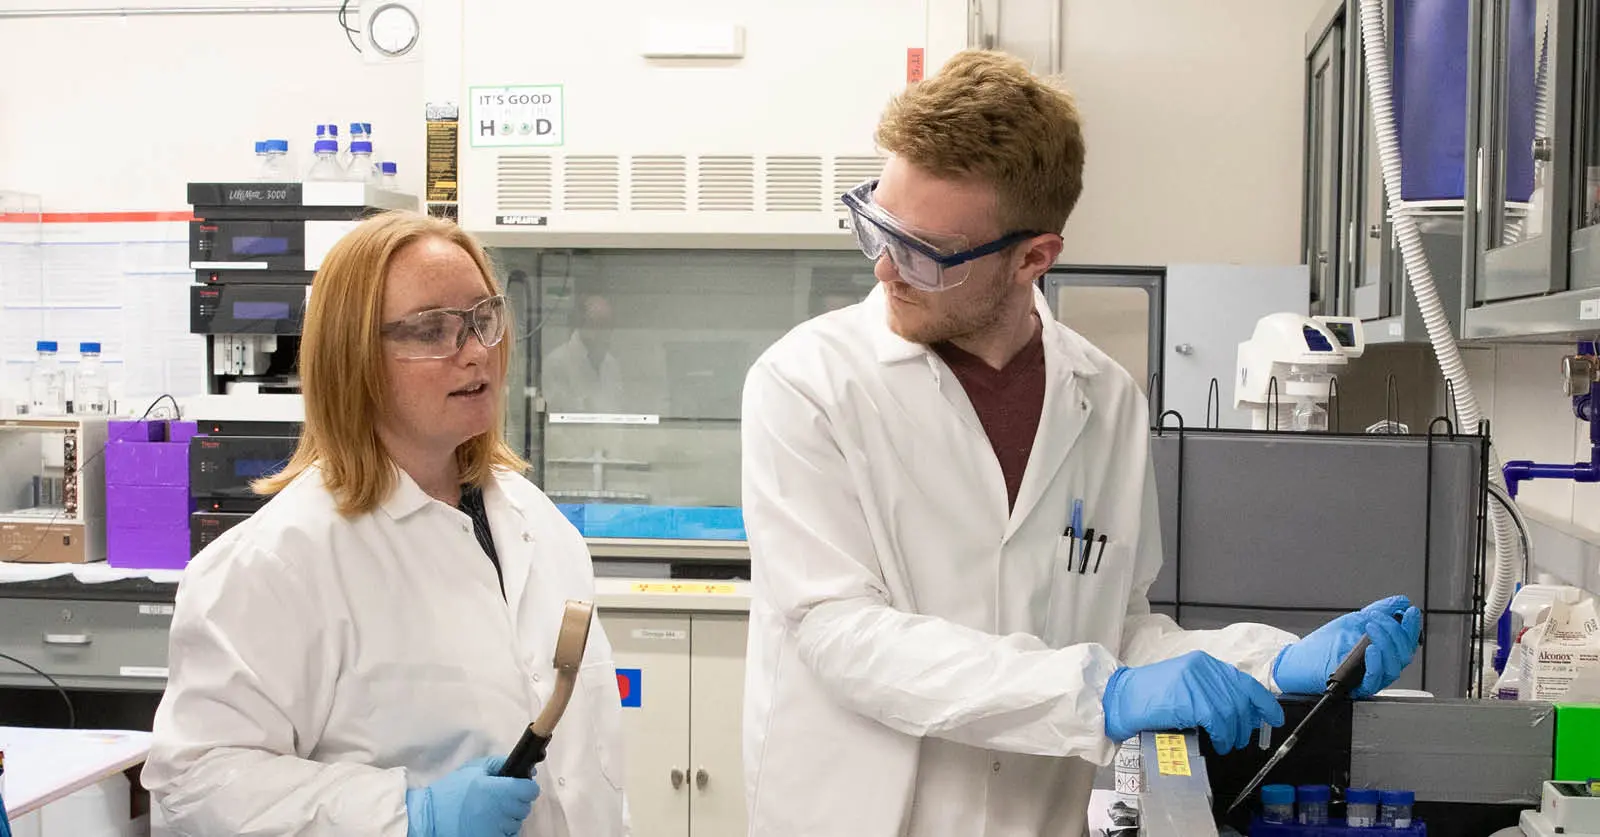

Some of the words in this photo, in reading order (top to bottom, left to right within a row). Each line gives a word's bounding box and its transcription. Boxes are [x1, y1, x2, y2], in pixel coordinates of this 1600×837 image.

[480, 95, 504, 105] IT'S
[508, 94, 552, 104] GOOD
[267, 190, 286, 200] 3000
